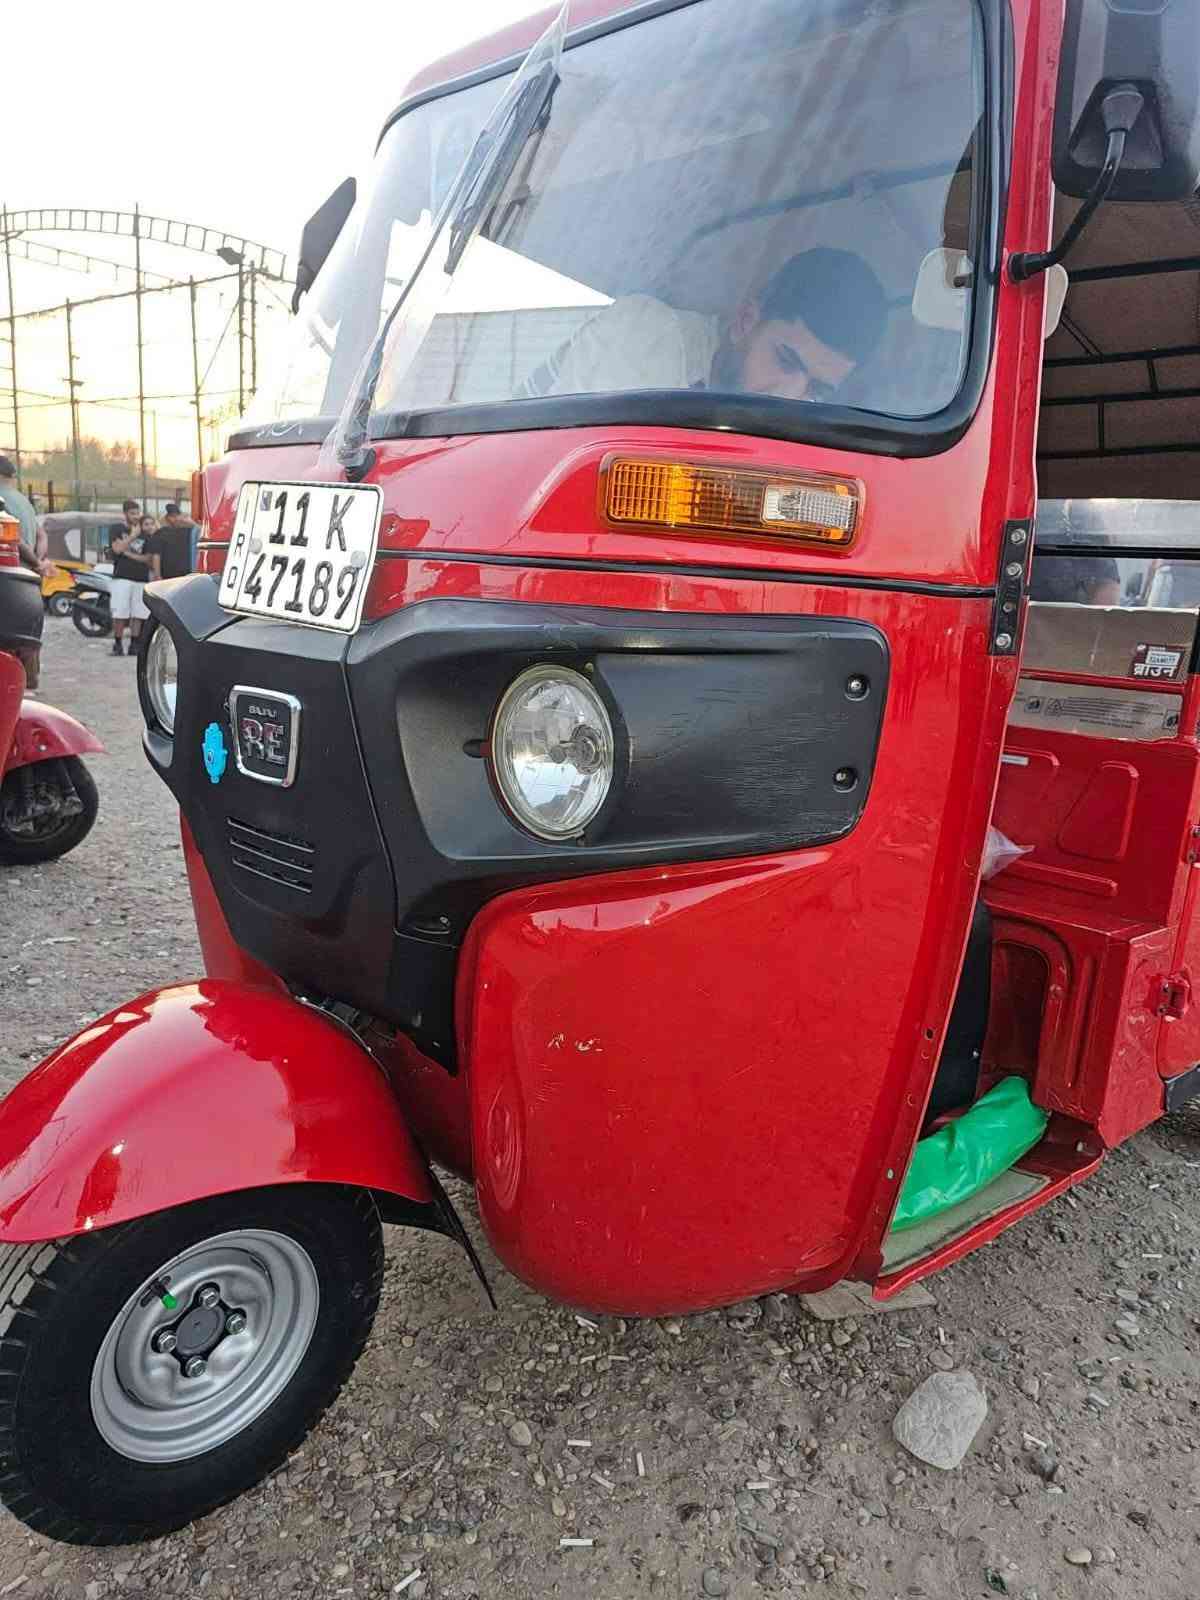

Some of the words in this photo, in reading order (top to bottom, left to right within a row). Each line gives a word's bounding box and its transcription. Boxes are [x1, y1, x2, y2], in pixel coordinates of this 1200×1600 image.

[268, 490, 311, 548] 11
[325, 494, 355, 551] K
[243, 553, 359, 620] 47189
[239, 716, 287, 766] RE
